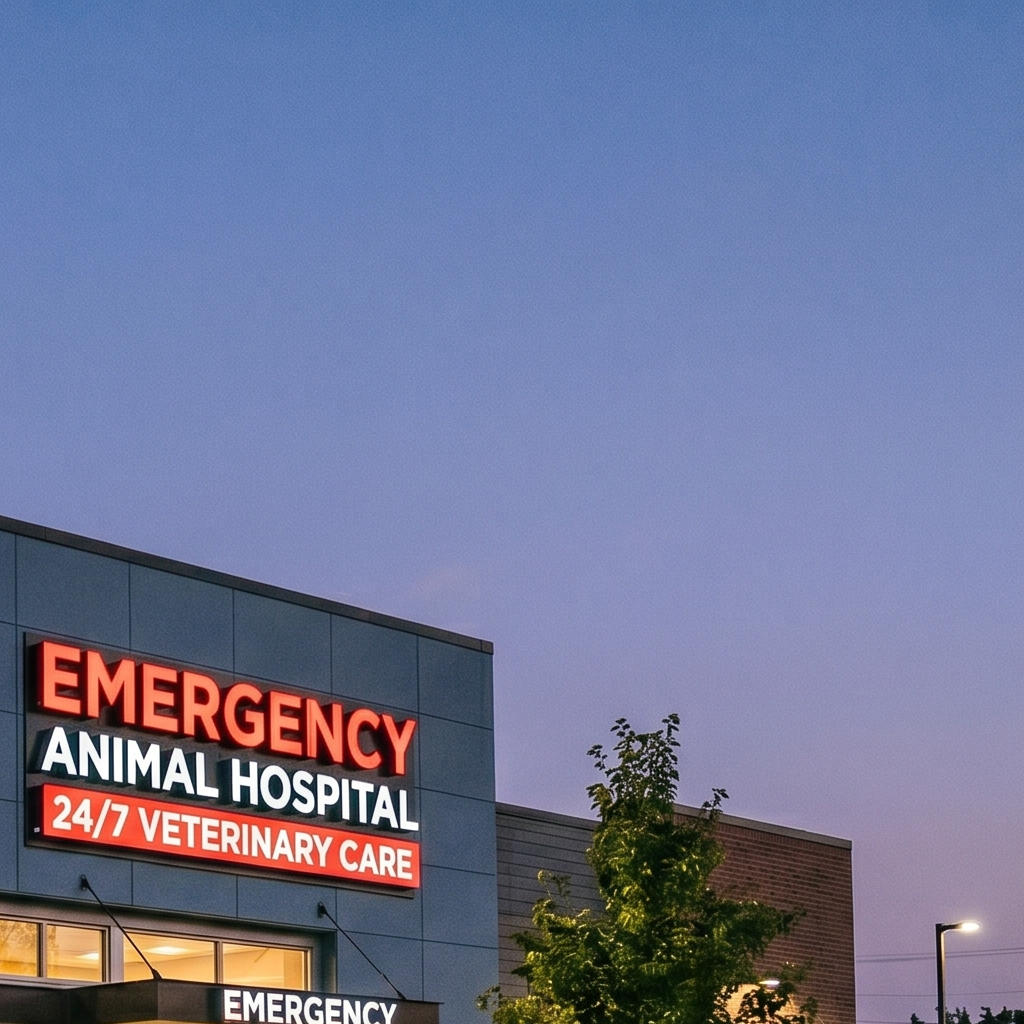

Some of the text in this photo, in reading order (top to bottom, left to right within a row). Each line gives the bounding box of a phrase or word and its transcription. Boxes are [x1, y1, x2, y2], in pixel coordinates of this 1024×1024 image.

[41, 641, 416, 775] EMERGENCY
[41, 726, 419, 831] ANIMAL HOSPITAL
[52, 794, 413, 880] 24/7 VETERINARY CARE
